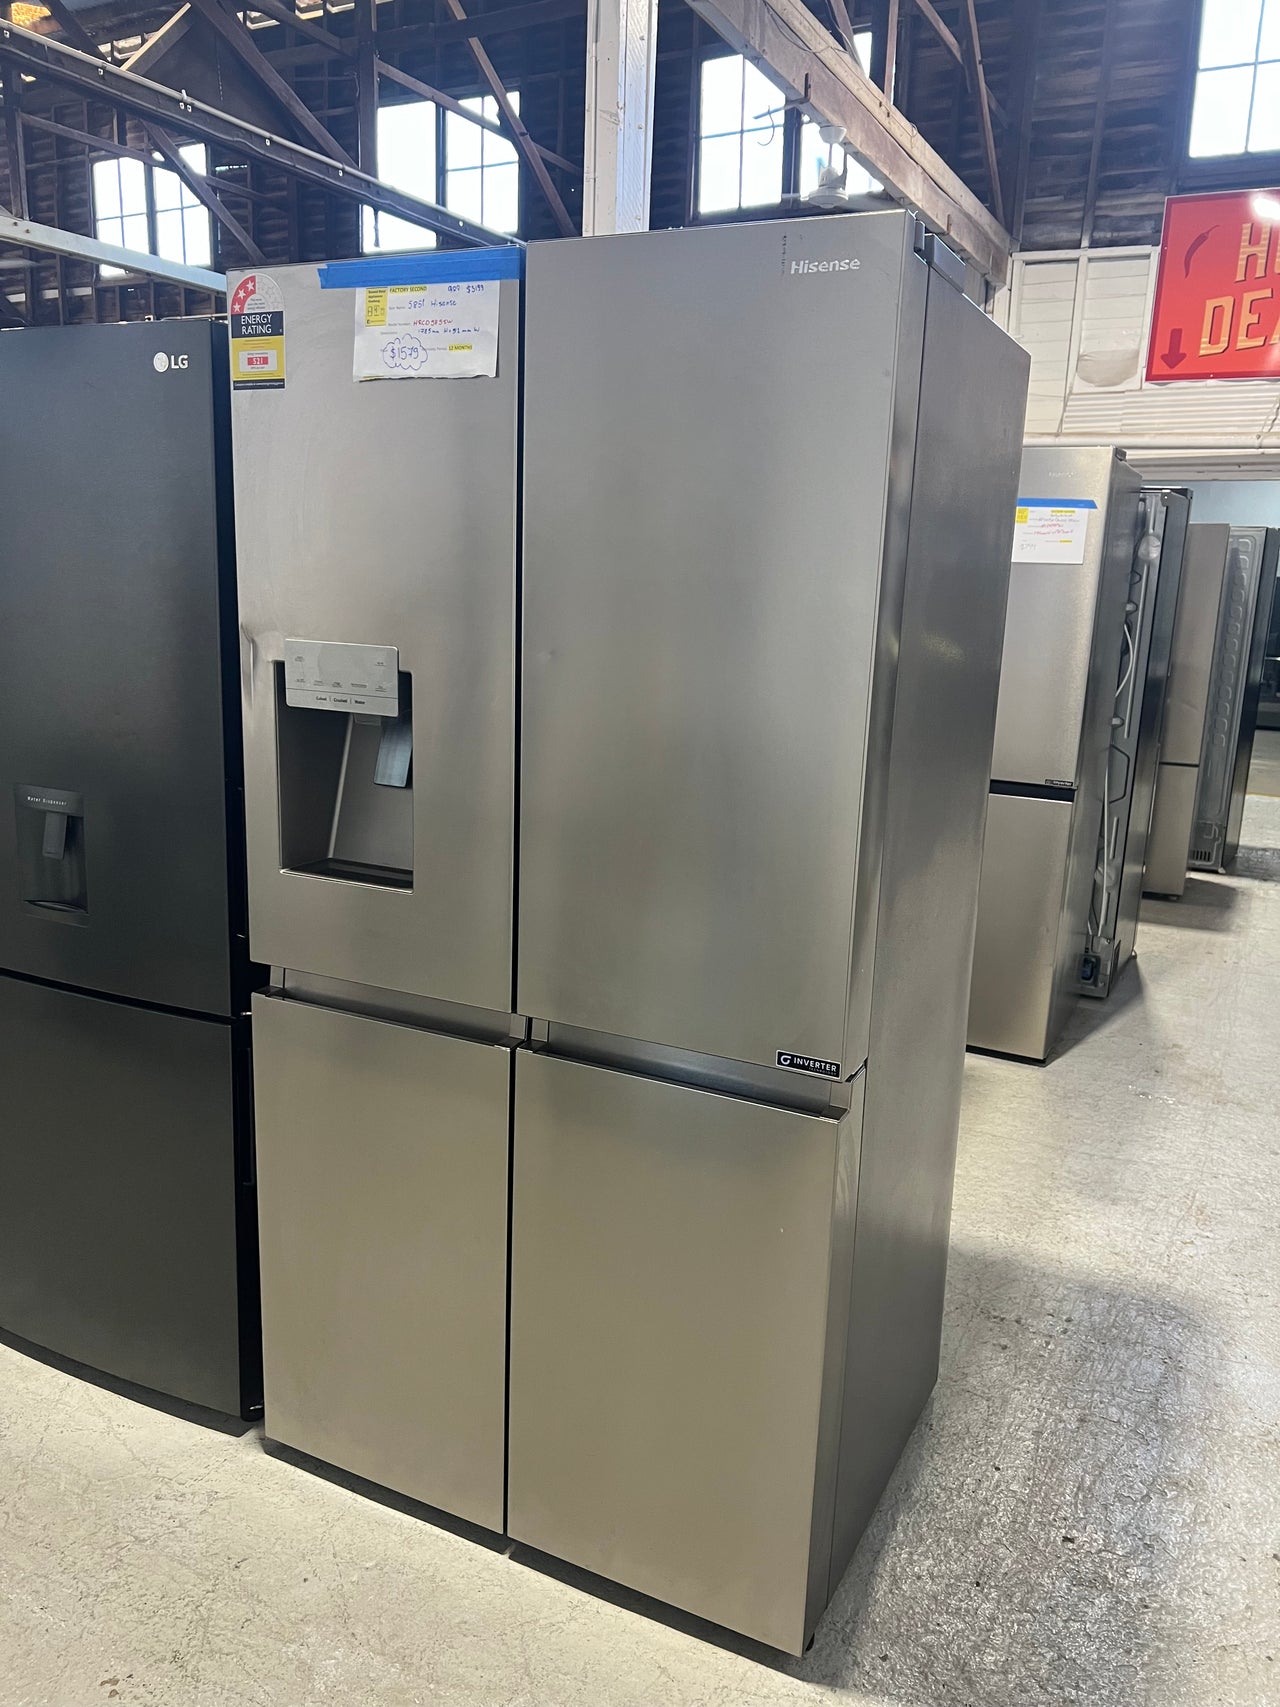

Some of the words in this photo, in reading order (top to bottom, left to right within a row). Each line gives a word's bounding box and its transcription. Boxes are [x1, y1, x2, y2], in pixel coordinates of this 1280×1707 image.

[1234, 221, 1280, 283] H
[790, 258, 861, 274] Hisense
[241, 313, 272, 325] ENERGY
[1198, 287, 1280, 358] DE
[241, 324, 272, 335] RATING
[170, 354, 189, 369] LG
[252, 357, 264, 365] 521
[793, 1057, 837, 1072] INVERTER
